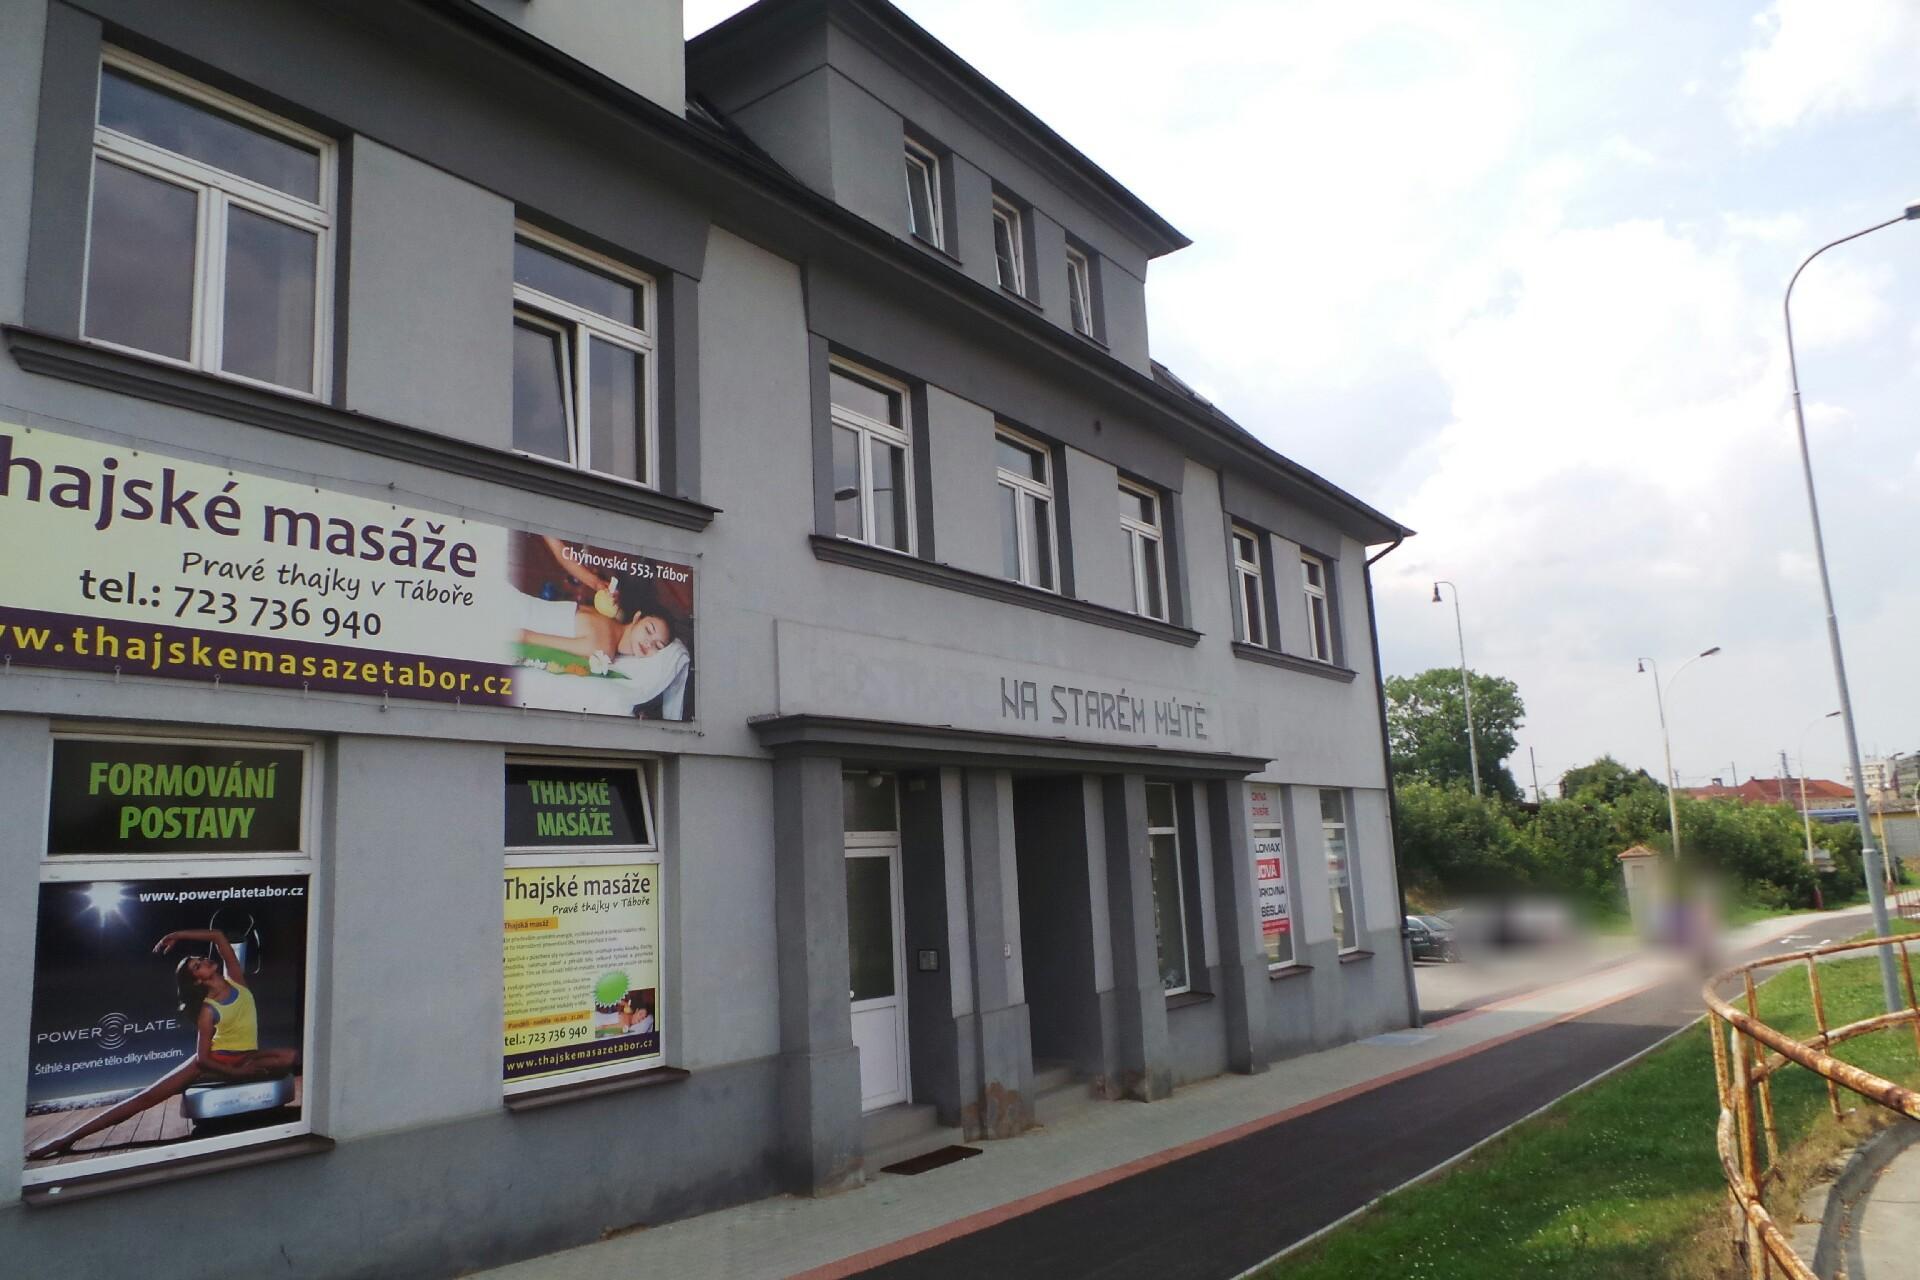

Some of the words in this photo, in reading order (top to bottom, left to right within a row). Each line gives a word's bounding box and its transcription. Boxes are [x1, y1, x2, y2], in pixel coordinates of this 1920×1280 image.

[264, 505, 477, 577] masáže
[182, 552, 265, 582] Pravé
[277, 563, 361, 600] thajky
[371, 580, 386, 595] v
[395, 579, 474, 606] Táboře
[562, 547, 628, 572] Chýnovská
[630, 562, 653, 580] 553,
[656, 565, 688, 583] Tábor
[79, 569, 161, 608] tel.:
[174, 586, 238, 624] 723
[250, 597, 311, 631] 736
[322, 608, 381, 639] 940
[0, 623, 513, 695] w.thajskemasazetabor.cz
[1000, 677, 1039, 721] NA
[1051, 685, 1146, 734] STARÉM
[88, 760, 279, 799] FORMOVÁNÍ
[527, 778, 611, 806] THAJSKÉ
[119, 806, 256, 839] POSTAVY
[537, 808, 614, 836] MASÁŽE
[139, 885, 304, 904] www.powerplatetabor.cz
[504, 875, 578, 905] Thajské
[583, 872, 650, 896] masáže
[552, 902, 578, 915] Pravé
[582, 900, 610, 913] thajky
[622, 897, 650, 908] Táboře
[37, 1026, 102, 1045] POWER
[123, 1019, 177, 1034] PLATE
[504, 1033, 526, 1046] tel.:
[528, 1032, 546, 1045] 723
[549, 1027, 566, 1042] 736
[569, 1026, 588, 1040] 940
[34, 1062, 63, 1075] Štíhlé
[72, 1058, 104, 1071] pevné
[104, 1055, 123, 1066] tělo
[123, 1053, 144, 1064] díky
[506, 1040, 653, 1071] www.thajskemasazetabor.cz
